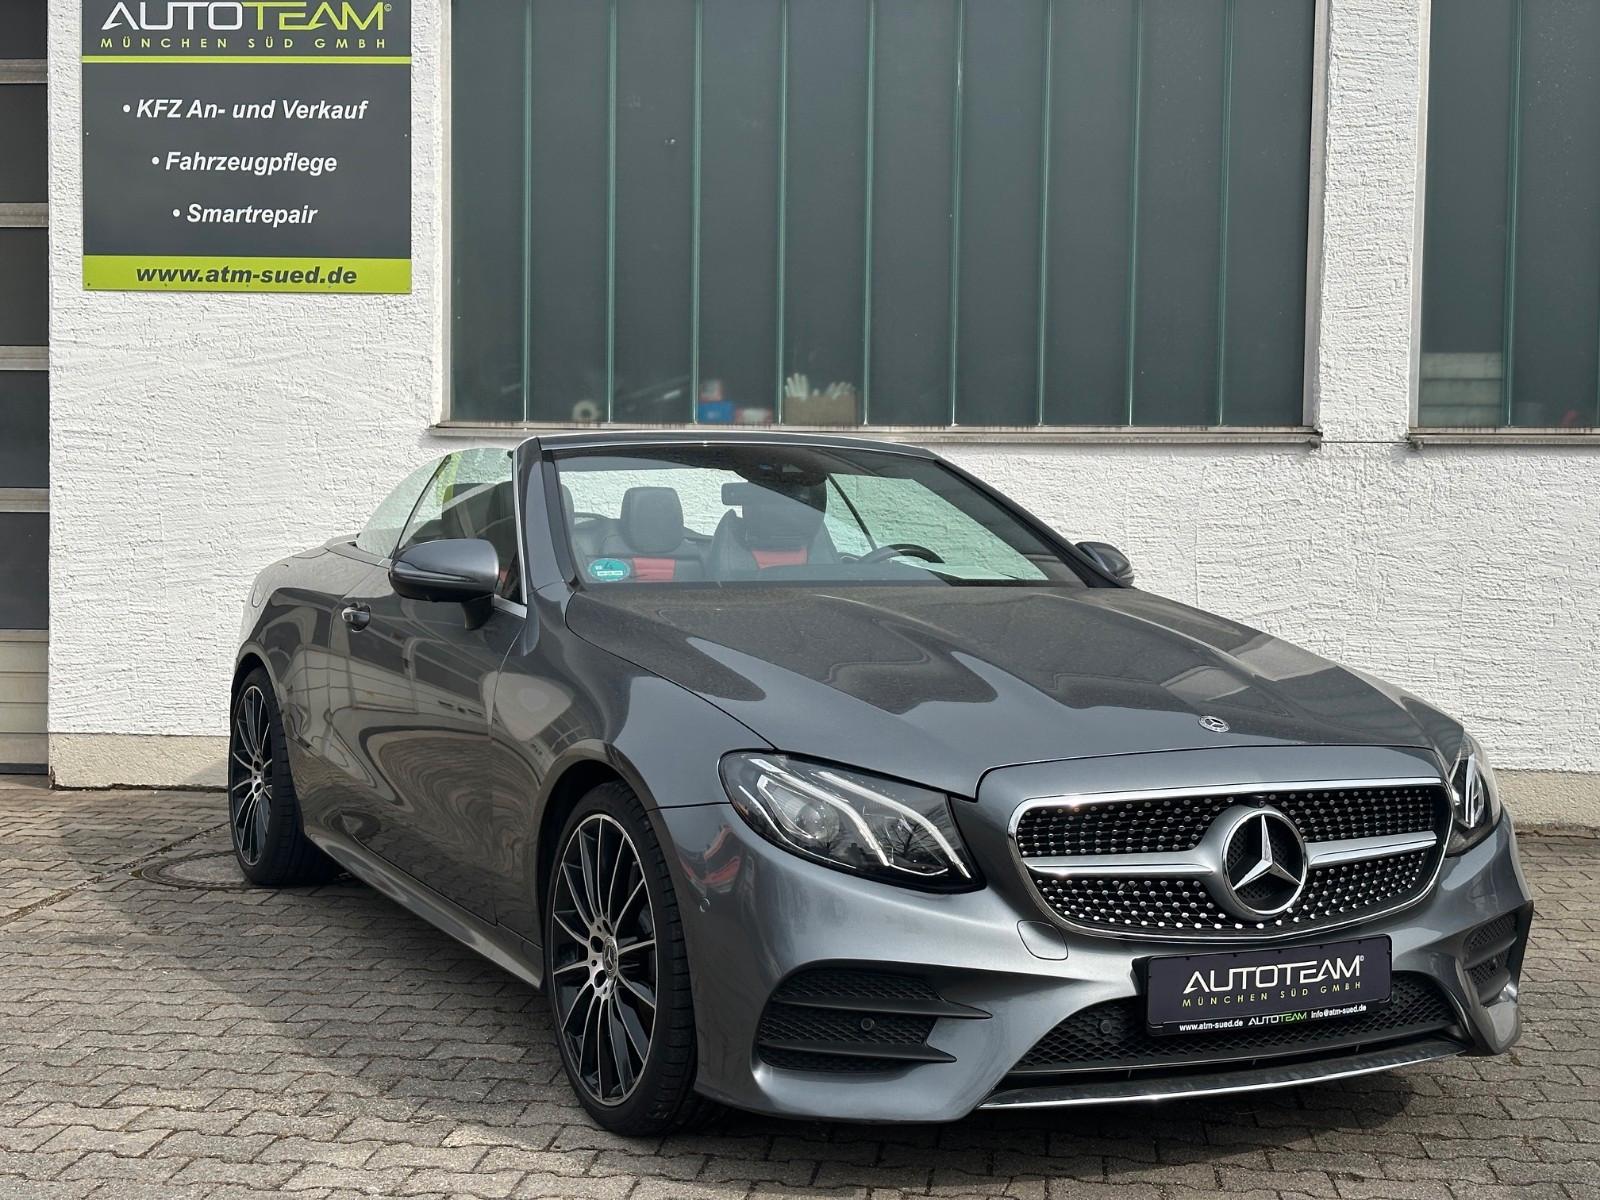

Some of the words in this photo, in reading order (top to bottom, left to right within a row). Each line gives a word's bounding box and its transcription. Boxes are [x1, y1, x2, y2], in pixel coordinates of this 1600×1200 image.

[100, 36, 228, 49] MÜNCHEN
[248, 36, 294, 49] SÜD
[315, 38, 386, 49] GMBH
[136, 100, 183, 119] KFZ
[187, 101, 226, 119] An-
[232, 101, 276, 119] und
[283, 101, 369, 120] Verkauf
[165, 152, 338, 176] Fahrzeugpflege
[186, 204, 318, 227] Smartrepair
[136, 266, 358, 285] www.atm-sued.de
[1183, 993, 1267, 1007] MÜNCHEN
[1280, 987, 1309, 999] SÜD
[1320, 982, 1361, 993] GMBH
[1179, 1019, 1243, 1031] www.atm-sued.de
[1248, 1012, 1307, 1026] AUTOTEAM
